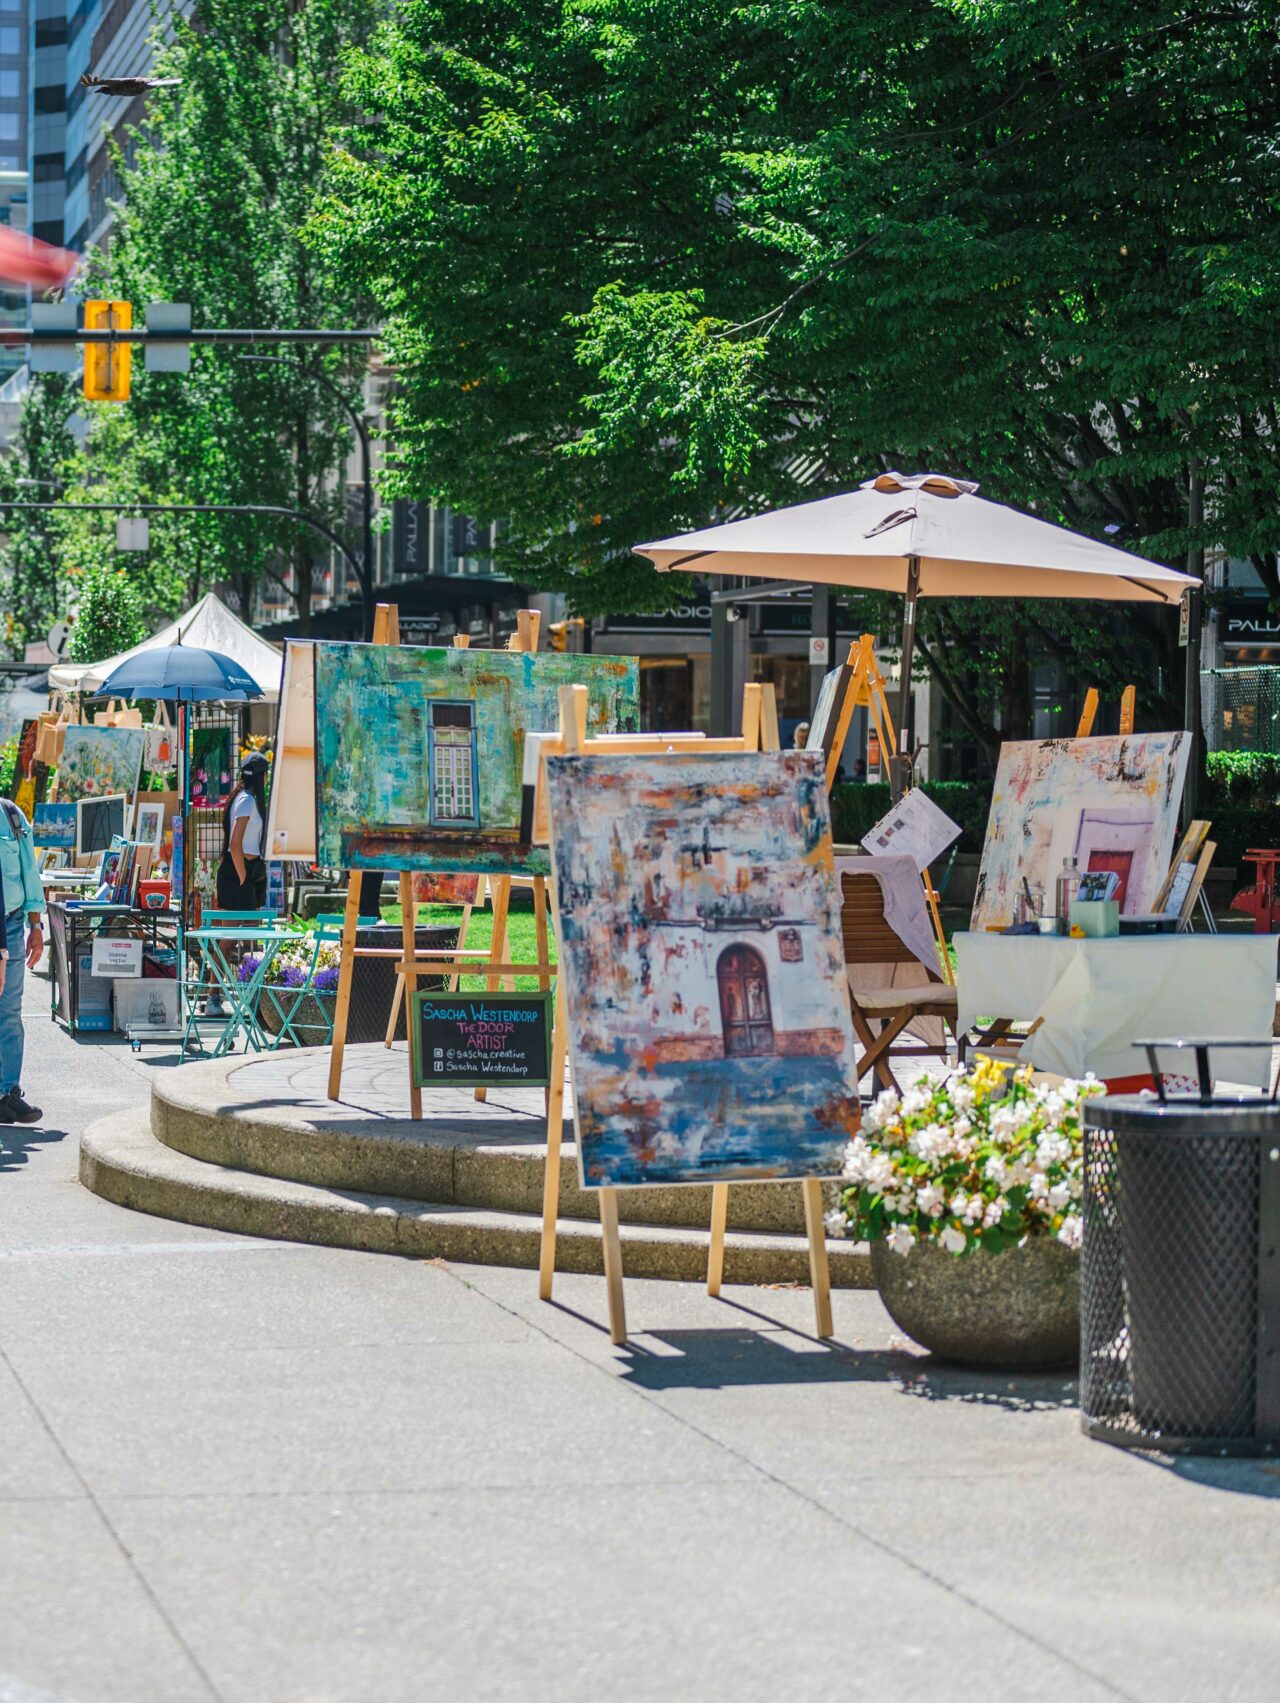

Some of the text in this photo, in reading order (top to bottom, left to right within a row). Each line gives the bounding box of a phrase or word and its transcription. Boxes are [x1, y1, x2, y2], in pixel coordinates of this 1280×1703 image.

[423, 1002, 538, 1023] SASCHA WESTENDORP
[479, 1022, 515, 1033] DOOR
[466, 1035, 508, 1049] ARTIST
[446, 1061, 528, 1076] Sascha Westendorp
